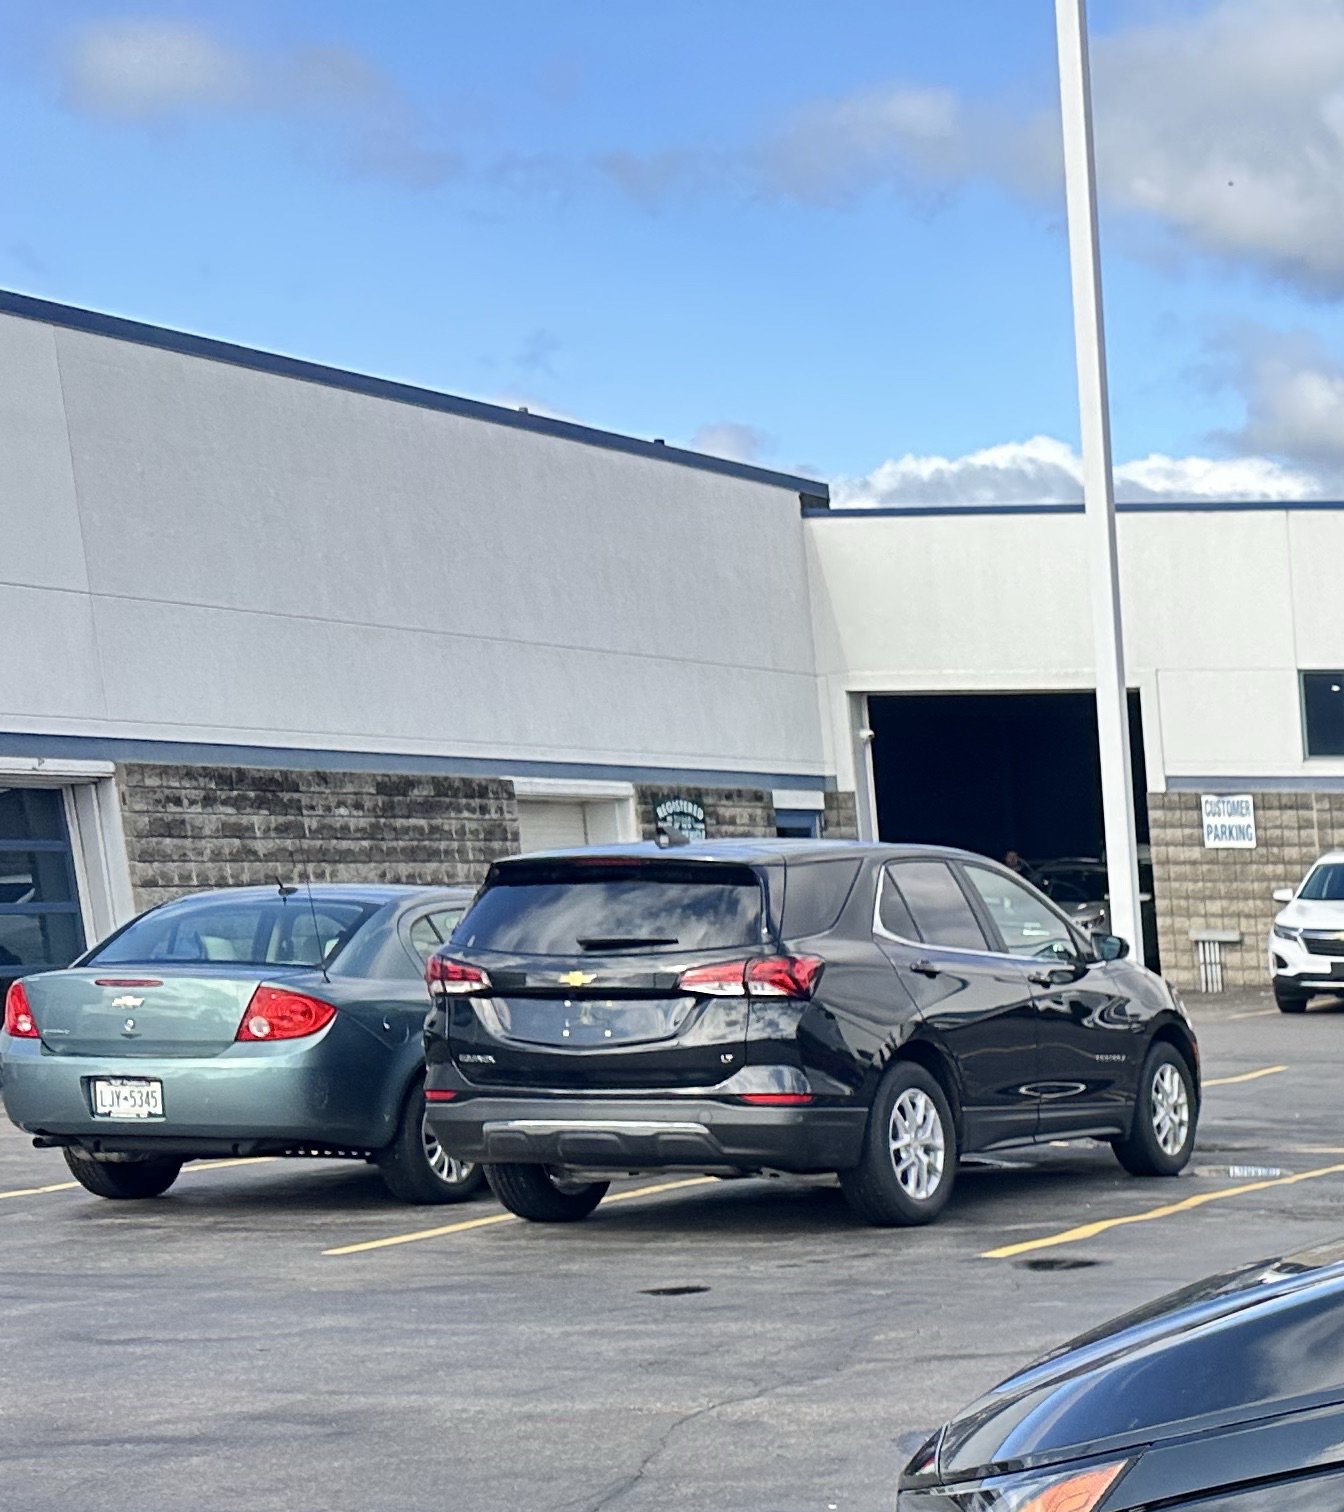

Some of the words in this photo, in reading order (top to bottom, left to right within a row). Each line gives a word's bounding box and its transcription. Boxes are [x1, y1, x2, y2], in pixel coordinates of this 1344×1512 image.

[656, 799, 704, 820] REGISTERED
[1204, 799, 1251, 817] CUSTOMER
[1206, 823, 1253, 842] PARKING
[129, 1089, 158, 1108] 5345
